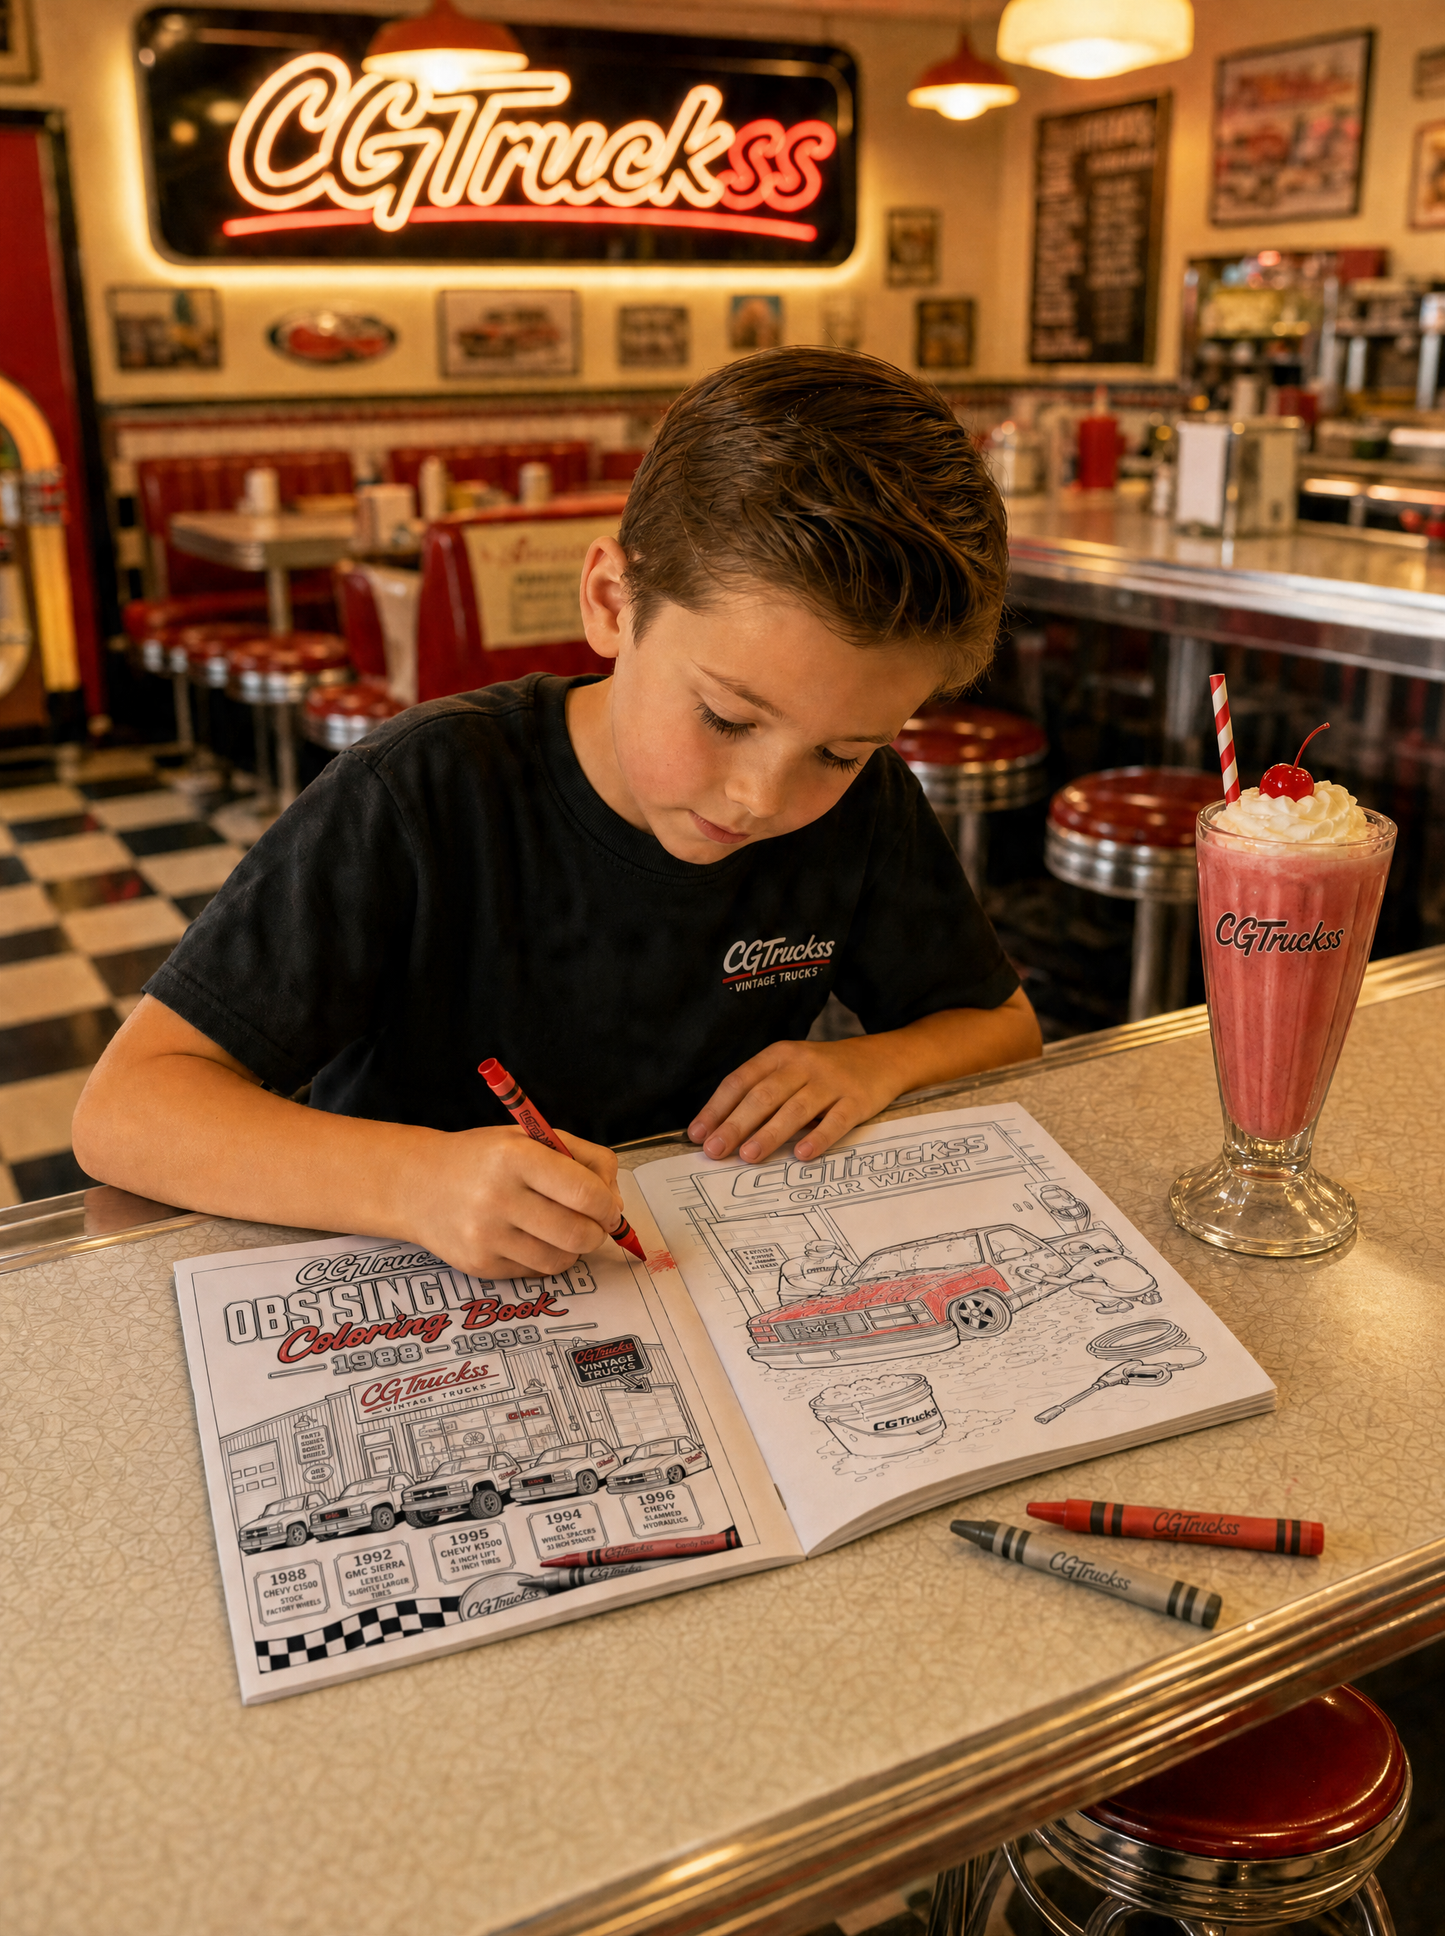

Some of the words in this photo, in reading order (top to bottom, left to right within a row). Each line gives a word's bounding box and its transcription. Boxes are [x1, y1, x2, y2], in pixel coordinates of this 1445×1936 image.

[228, 51, 838, 232] CGTruckss
[1215, 911, 1345, 957] CGTruckss
[723, 934, 836, 975] CGTruckss
[735, 975, 776, 992] VINTAGE
[779, 966, 819, 982] TRUCKS
[789, 1180, 864, 1203] CAR
[868, 1159, 970, 1188] WASH
[223, 1289, 325, 1345] OBS
[277, 1313, 452, 1363] Coloring
[460, 1292, 569, 1329] Book
[331, 1343, 423, 1375] 1988
[451, 1325, 541, 1355] 1998
[579, 1354, 636, 1372] VINTAGE
[585, 1362, 636, 1380] TRUCKS
[361, 1361, 489, 1407] CGTruckss
[385, 1396, 434, 1413] VINTAGE
[442, 1383, 487, 1398] TRUCKS
[873, 1407, 938, 1431] CGTrucks
[637, 1489, 675, 1506] 1996
[545, 1508, 582, 1525] 1994
[643, 1502, 675, 1514] CHEVY
[555, 1522, 576, 1533] GMC
[643, 1516, 689, 1530] HYDRAULICS
[1153, 1511, 1240, 1537] CGTruckss
[449, 1528, 489, 1546] 1995
[440, 1545, 471, 1558] CHEVY
[474, 1538, 503, 1551] K1500
[458, 1554, 478, 1563] INCH
[480, 1550, 496, 1559] LIFT
[354, 1549, 393, 1567] 1992
[450, 1566, 460, 1574] 33
[461, 1561, 479, 1571] INCH
[270, 1568, 307, 1586] 1988
[345, 1567, 368, 1579] GMC
[370, 1560, 406, 1574] SIERRA
[1049, 1551, 1131, 1591] CGTruckss
[263, 1586, 291, 1599] CHEVY
[293, 1580, 318, 1592] C1500
[266, 1604, 295, 1616] FACTORY
[296, 1598, 321, 1609] WHEELS
[280, 1594, 303, 1605] STOCK
[467, 1587, 540, 1619] CGTruckss
